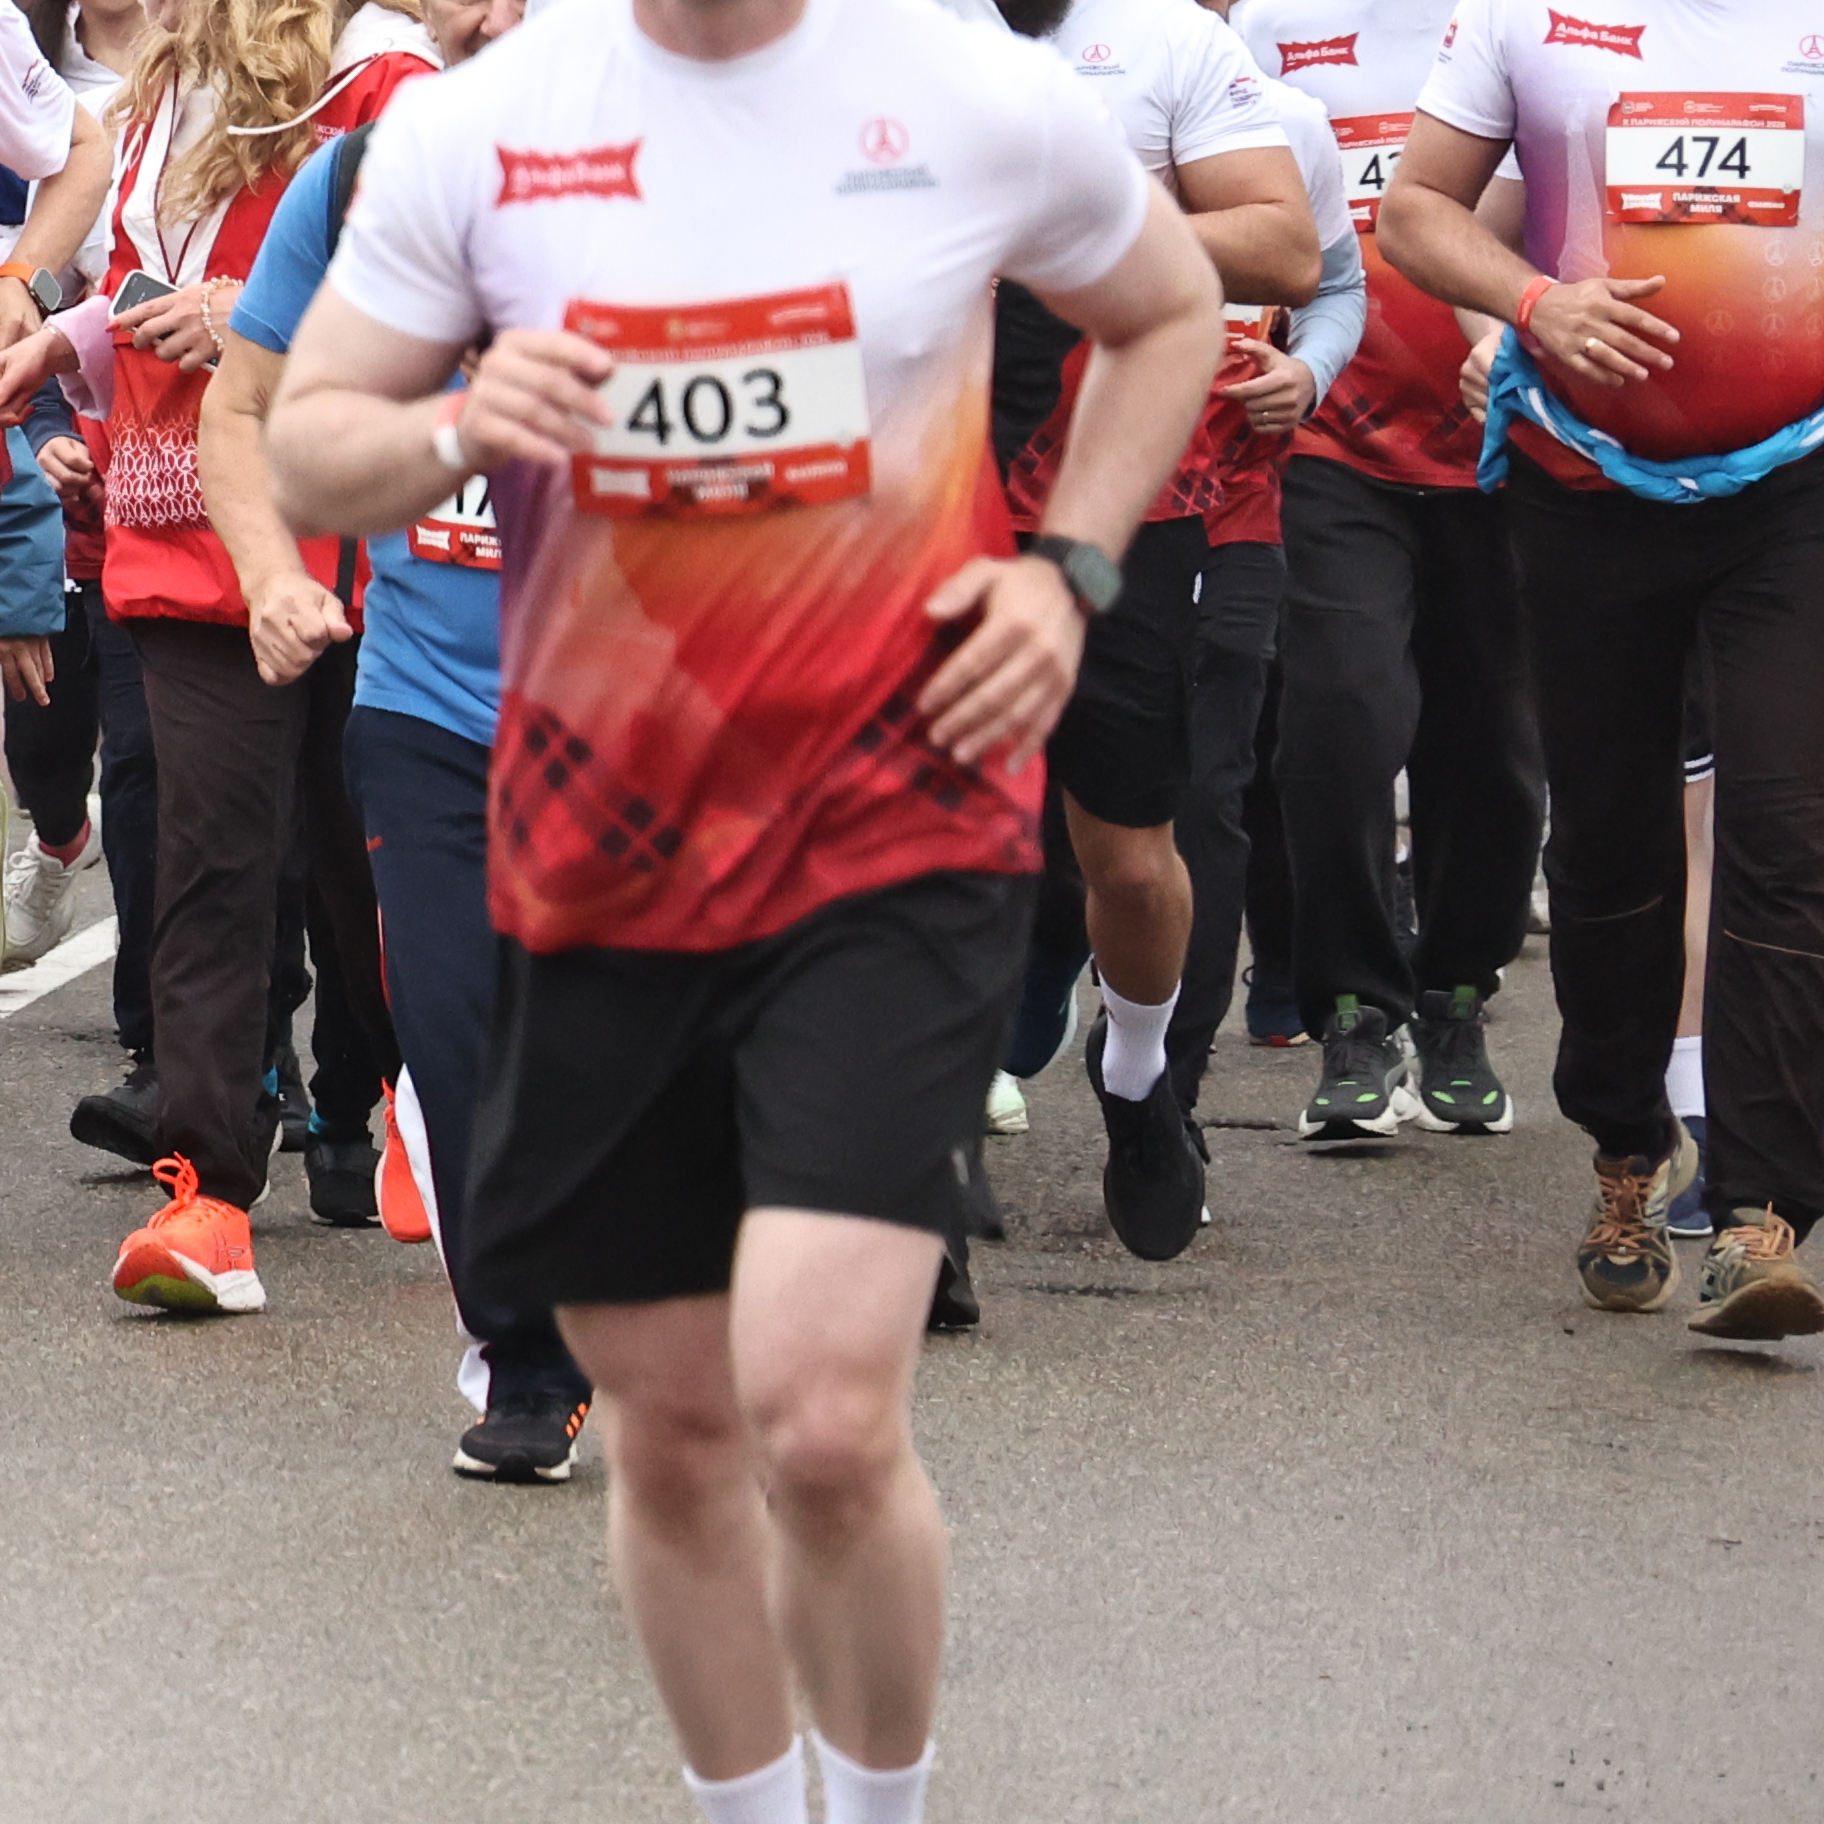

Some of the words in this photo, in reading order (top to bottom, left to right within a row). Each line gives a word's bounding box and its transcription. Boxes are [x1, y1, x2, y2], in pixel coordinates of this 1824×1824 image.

[1556, 23, 1598, 39] Альфа
[1600, 31, 1633, 46] Банк
[1655, 135, 1751, 179] 474
[626, 368, 790, 446] 403
[475, 546, 502, 559] МИЛ
